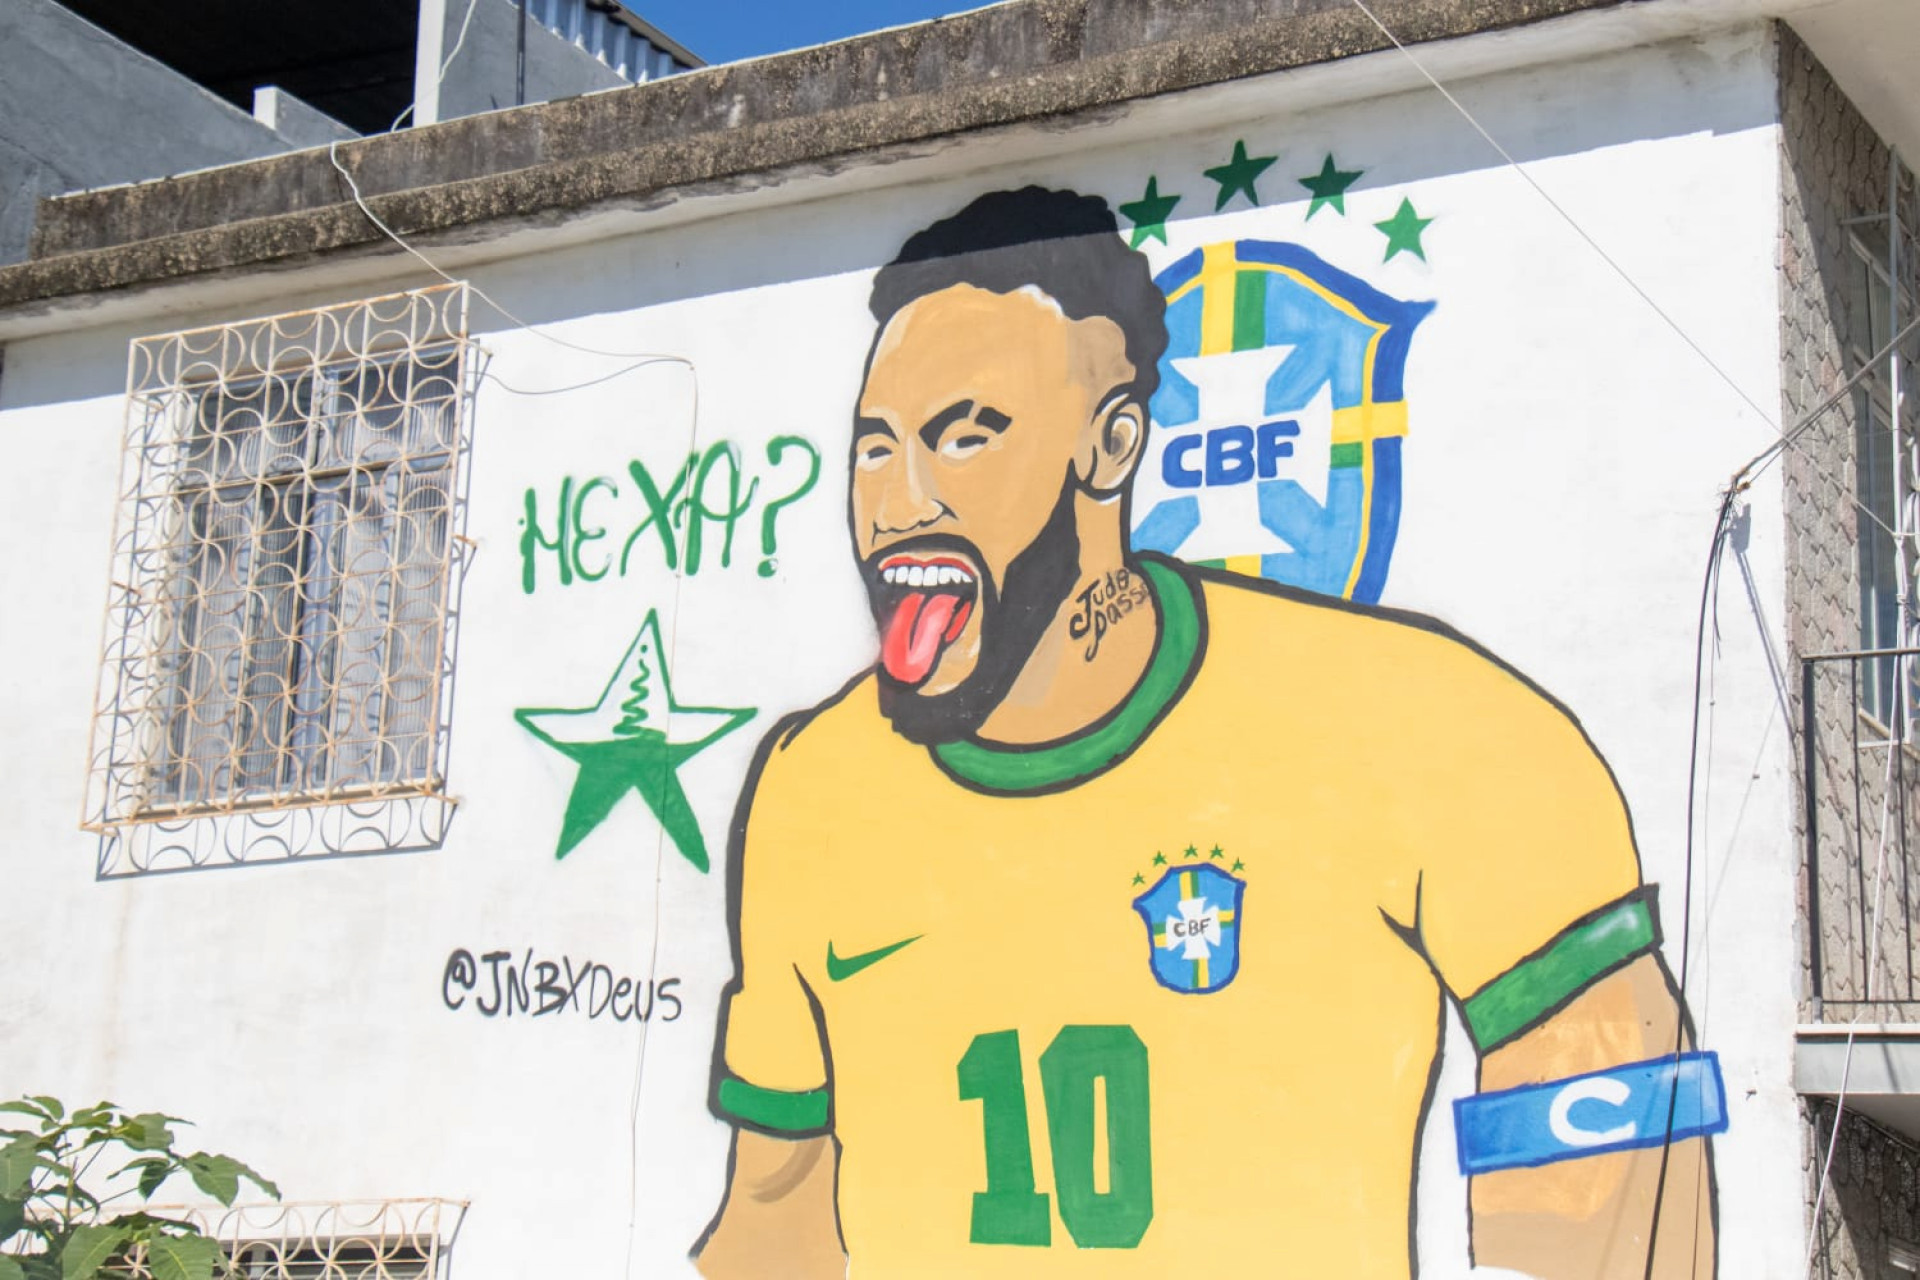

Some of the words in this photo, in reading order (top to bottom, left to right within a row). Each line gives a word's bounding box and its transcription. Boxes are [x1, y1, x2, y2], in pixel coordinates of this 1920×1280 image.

[1161, 419, 1301, 489] CBF
[518, 435, 822, 595] HEXA?
[1173, 917, 1212, 938] CBF
[956, 1023, 1154, 1250] 10
[1549, 1076, 1637, 1148] C
